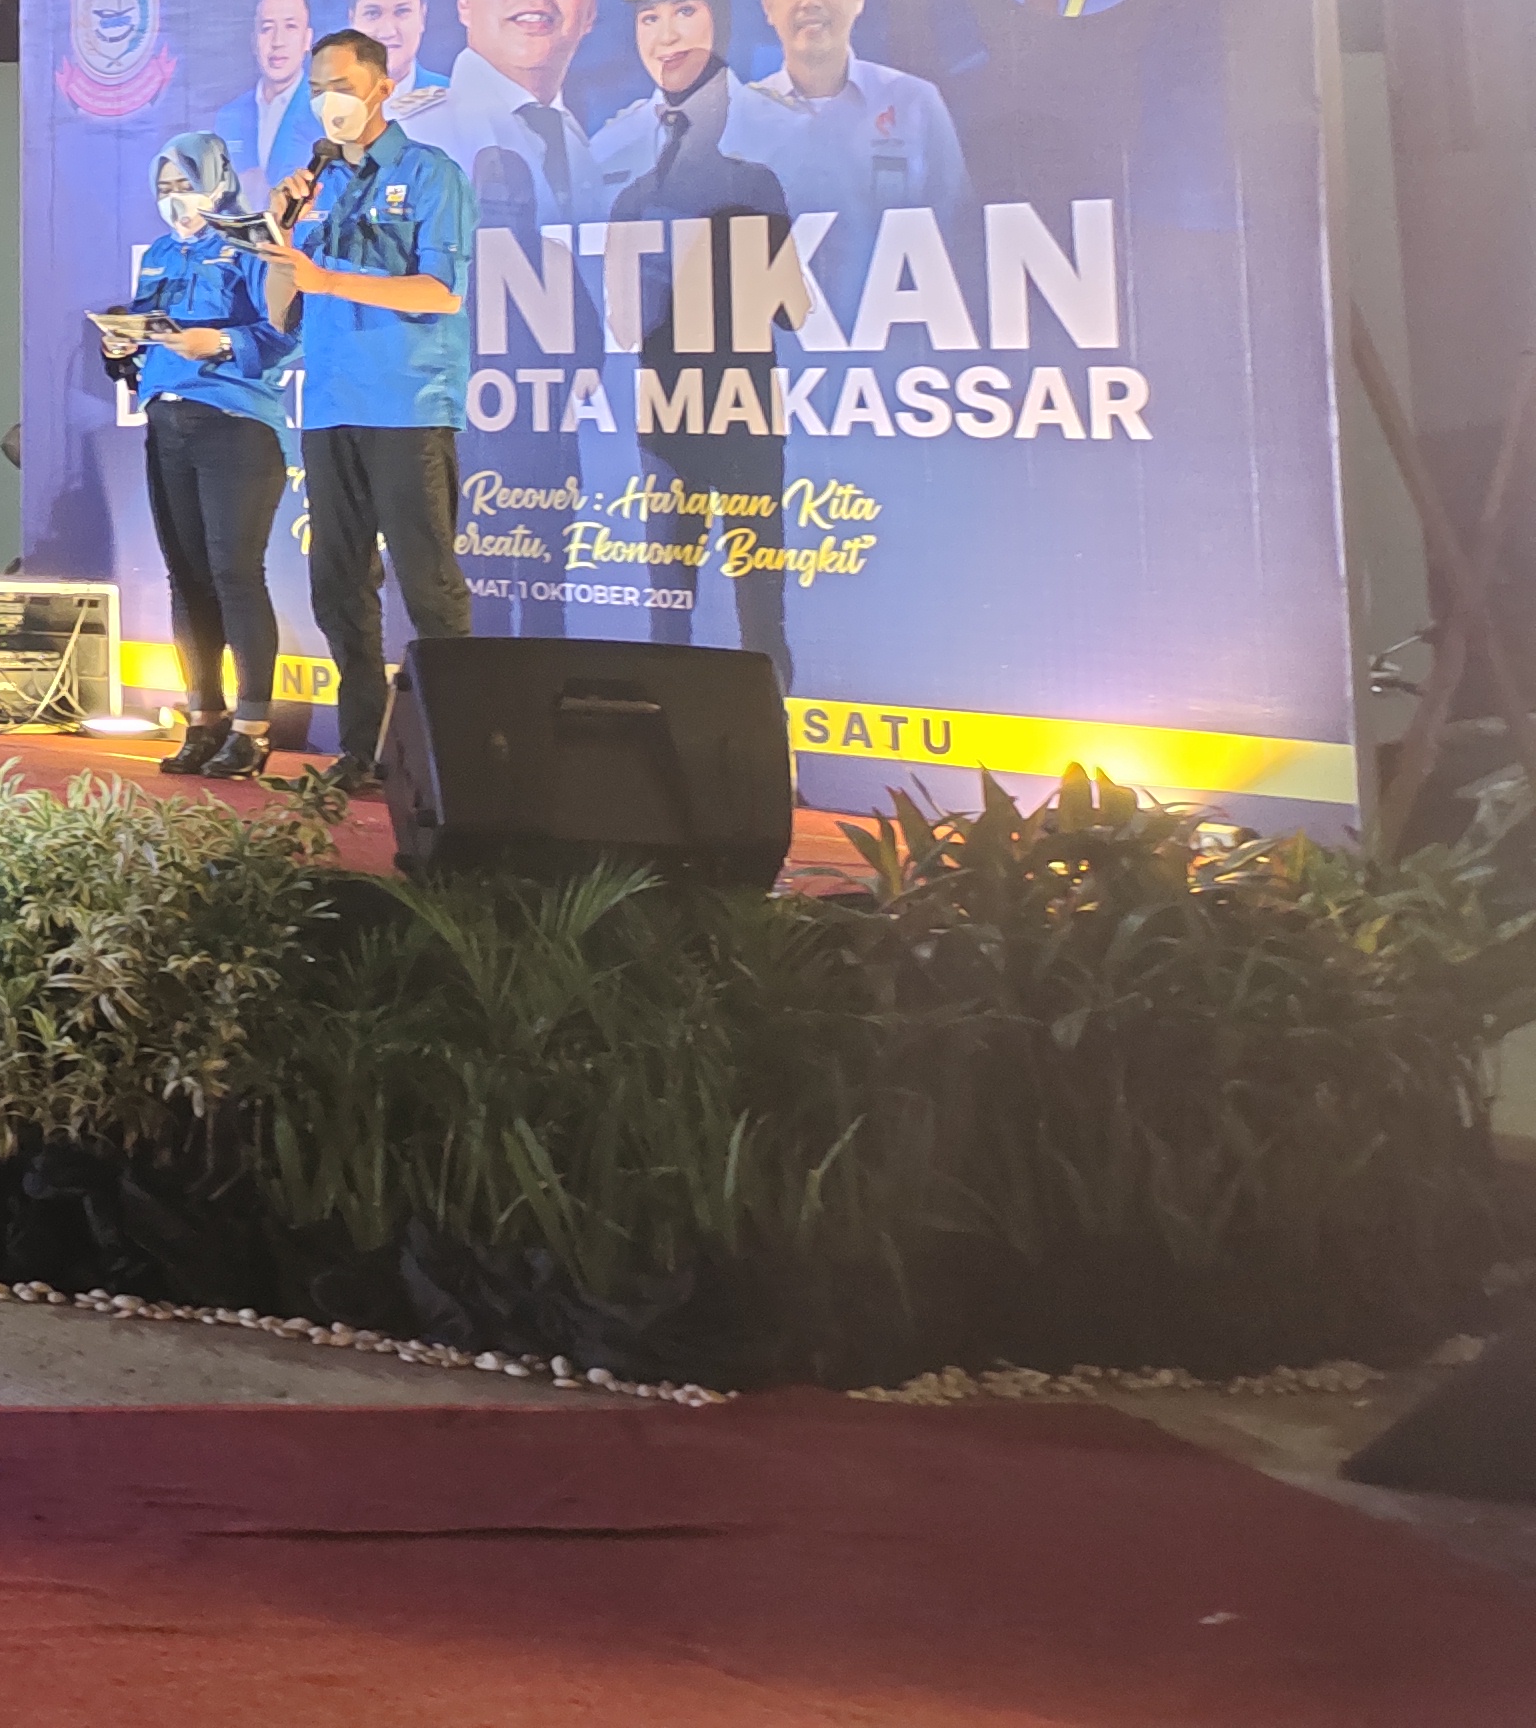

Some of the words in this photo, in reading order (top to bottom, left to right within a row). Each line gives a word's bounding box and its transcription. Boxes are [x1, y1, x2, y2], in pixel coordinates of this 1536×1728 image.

[475, 198, 1120, 355] NTIKAN
[466, 368, 618, 433] OTA
[636, 366, 1154, 440] MAKASSAR
[462, 470, 589, 516] Recover
[607, 473, 778, 529] Harapan
[782, 478, 883, 529] Kita
[453, 522, 552, 563] ersatu,
[562, 521, 711, 570] Ekonomi
[464, 577, 515, 601] MAT,
[531, 582, 639, 606] OKTOBER
[643, 588, 693, 609] 2021
[803, 708, 951, 755] SATU
